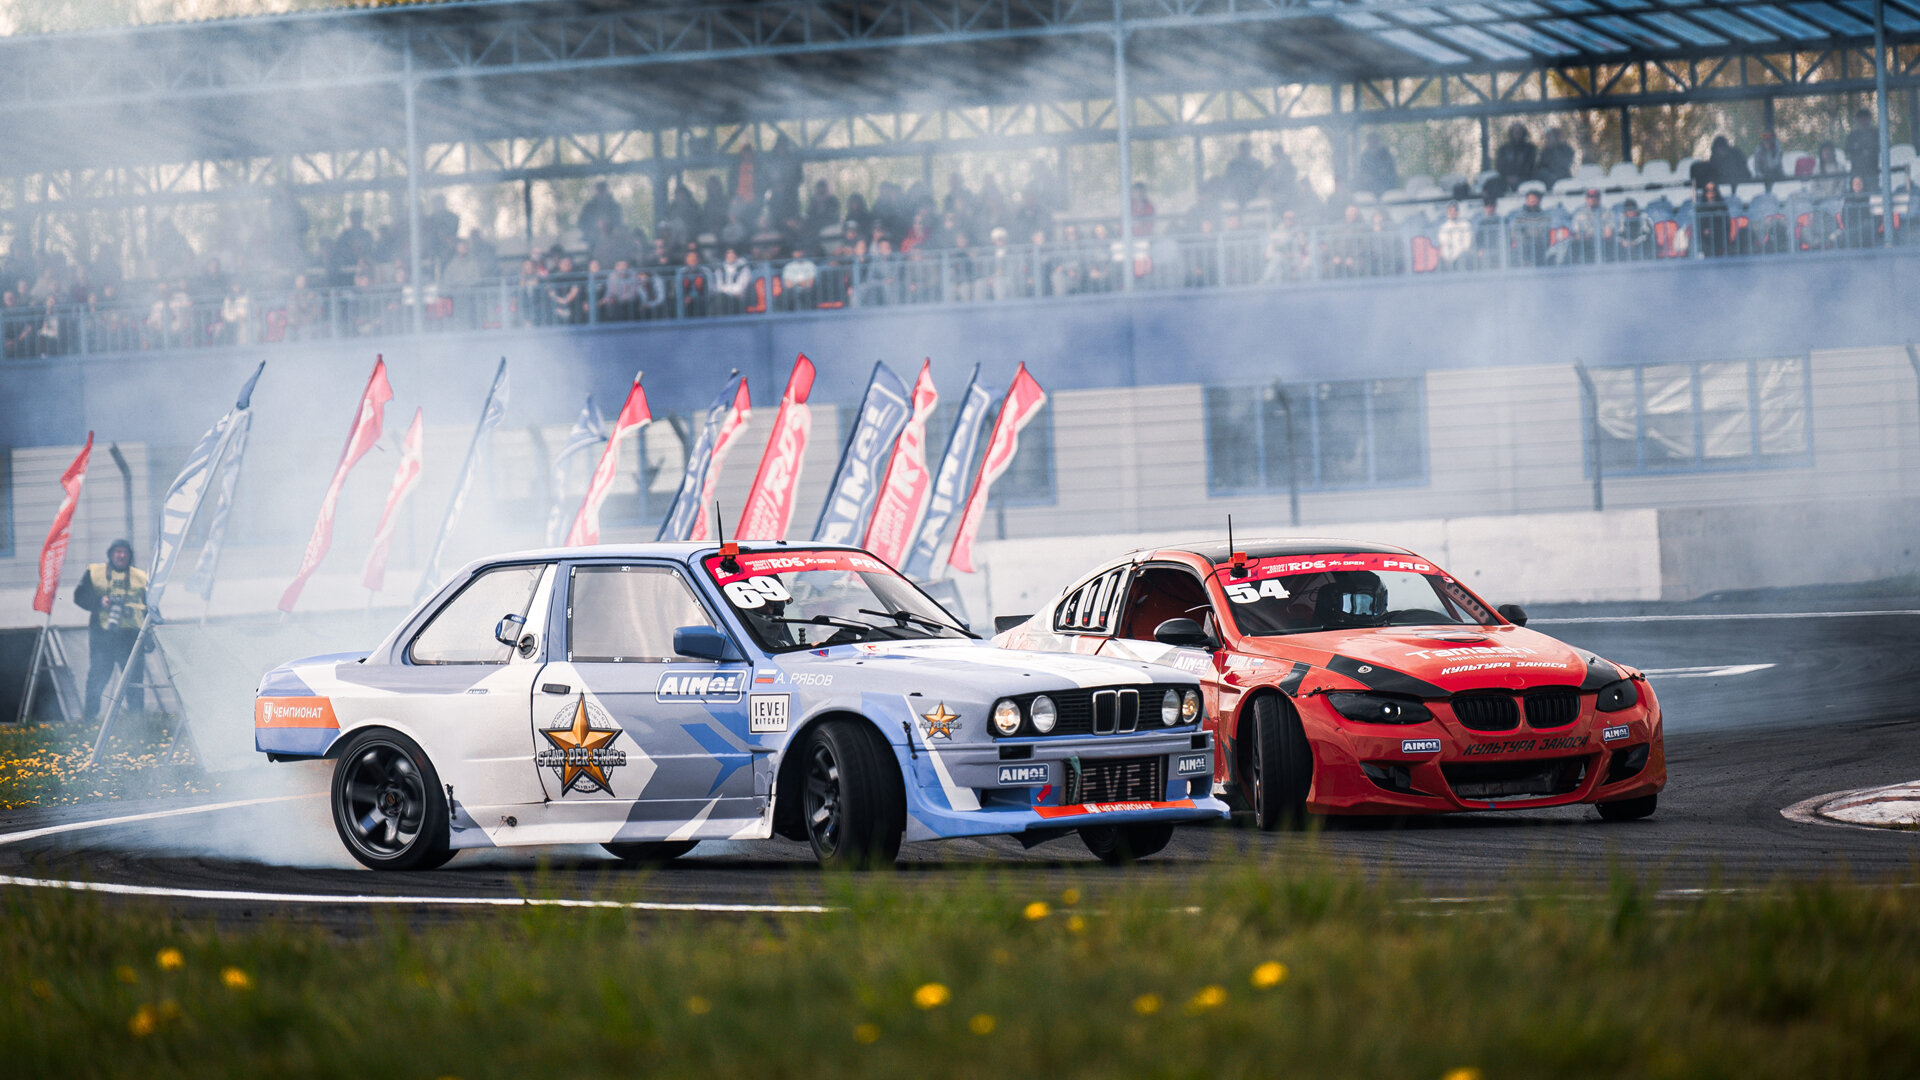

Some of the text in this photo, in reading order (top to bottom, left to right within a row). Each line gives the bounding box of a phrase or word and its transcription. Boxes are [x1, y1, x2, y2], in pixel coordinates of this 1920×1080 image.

[769, 557, 805, 569] RDS
[848, 558, 889, 571] PRO
[1288, 560, 1326, 571] RDS
[1383, 560, 1430, 571] PRO
[723, 576, 791, 609] 69
[1224, 579, 1290, 604] 54
[1405, 646, 1539, 660] Tamashi
[1441, 661, 1568, 675] КУЛЬТУРА ЗАНОСА
[660, 676, 739, 696] AIMOL
[775, 672, 833, 686] А. РЯБОВ
[273, 706, 323, 718] ЧЕМПИОНАТ
[1404, 742, 1439, 750] AIMOL
[1463, 736, 1588, 756] КУЛЬТУРА ЗАНОСА
[538, 749, 566, 767] STAR
[592, 748, 626, 767] STARS
[1178, 757, 1206, 771] AIMOL
[1000, 767, 1047, 781] AIMOL
[1099, 803, 1154, 813] ЧЕМПИОНАТ
